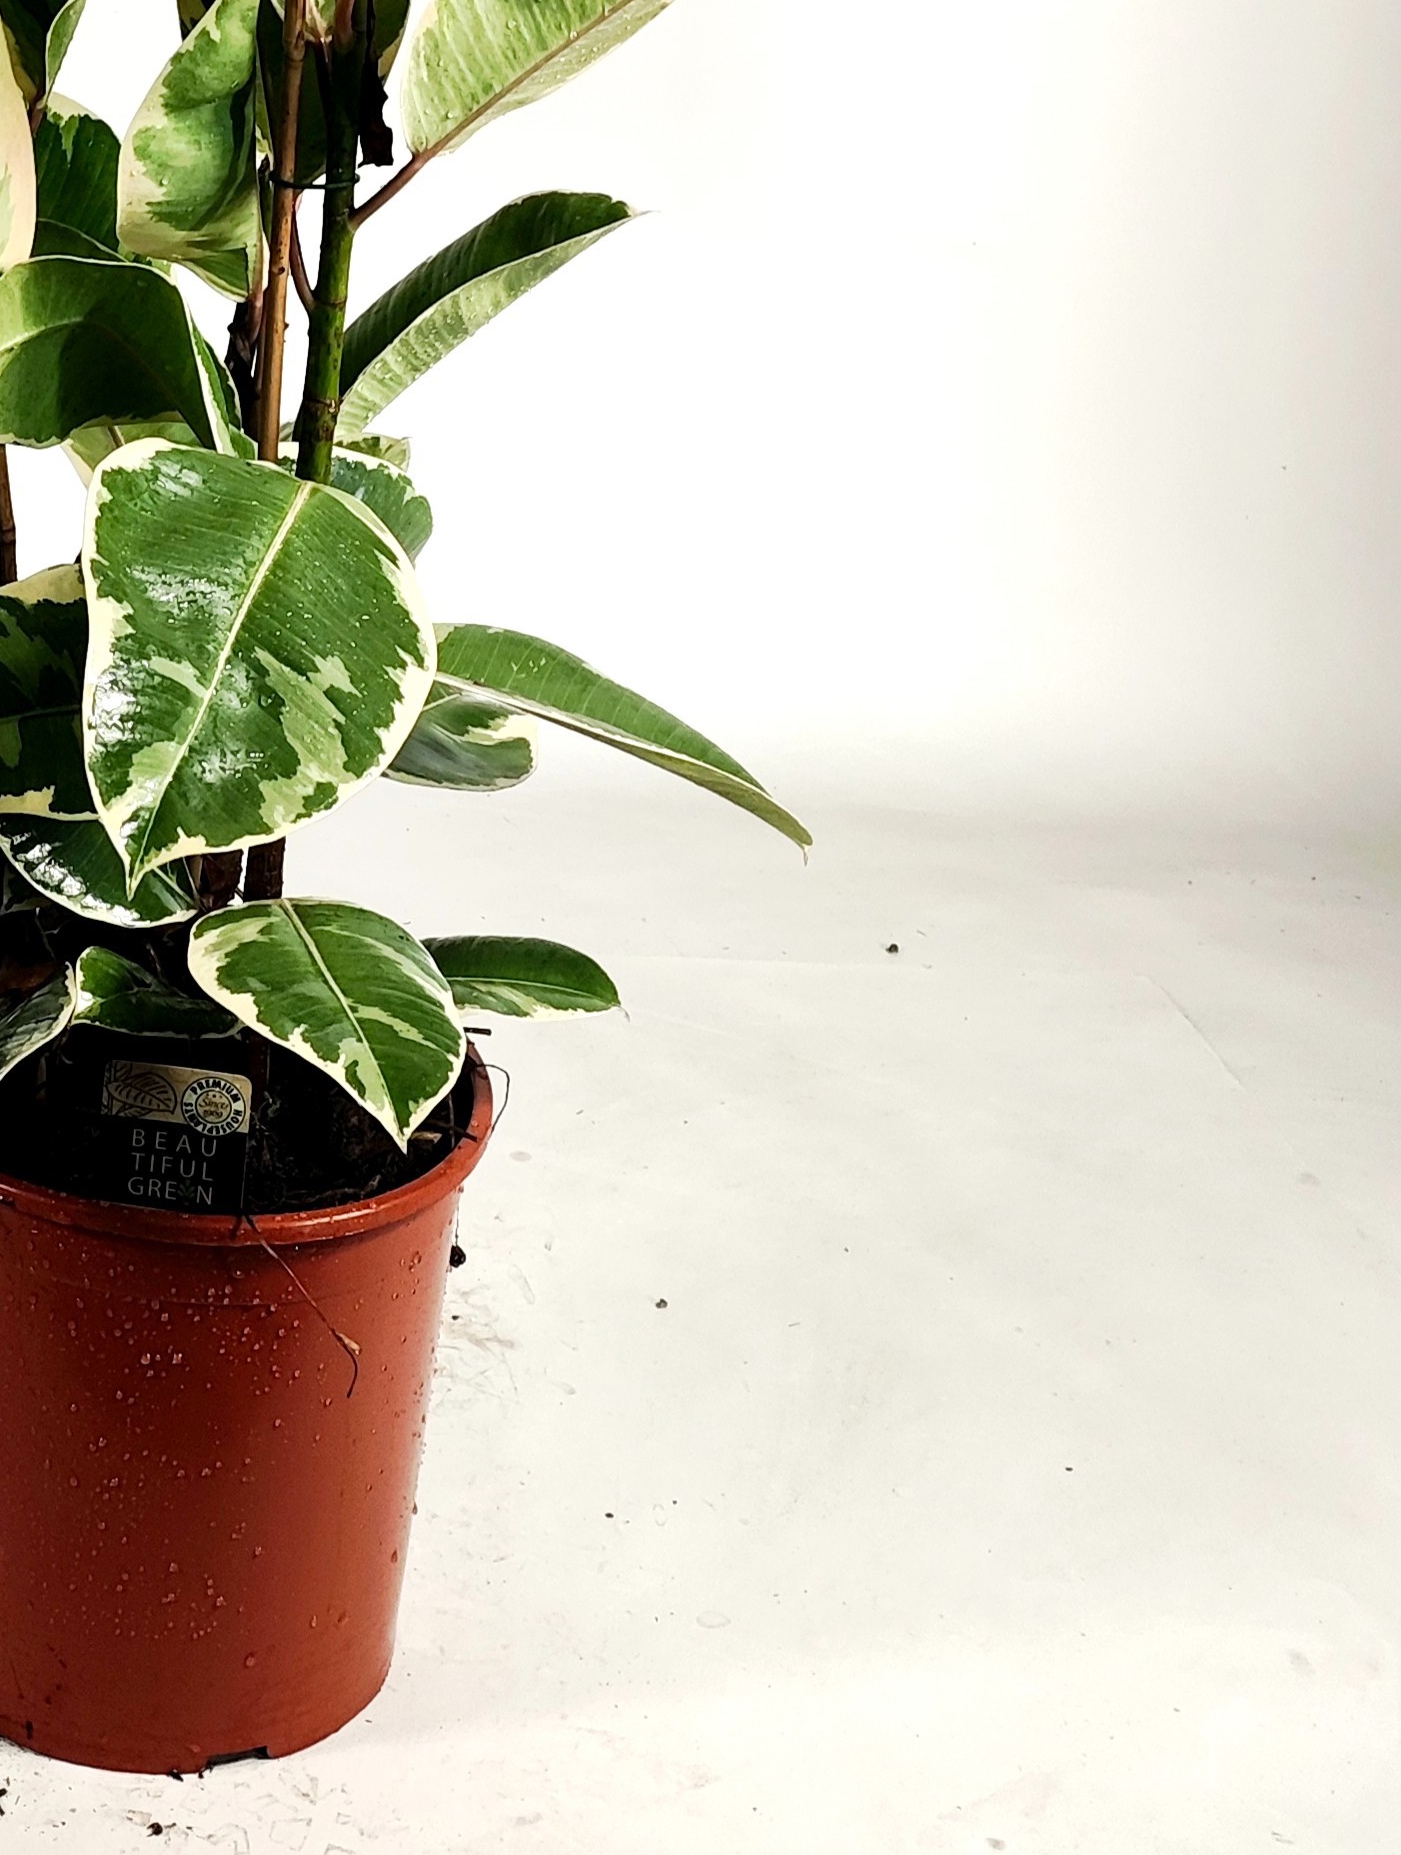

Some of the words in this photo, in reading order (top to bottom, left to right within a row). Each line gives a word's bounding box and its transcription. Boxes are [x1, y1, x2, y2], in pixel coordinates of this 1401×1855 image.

[190, 1079, 241, 1103] PREMIUM
[183, 1102, 243, 1135] HOUSEPLANTS
[132, 1128, 217, 1157] BEAU
[131, 1152, 213, 1182] TIFUL
[128, 1177, 213, 1205] GREN
